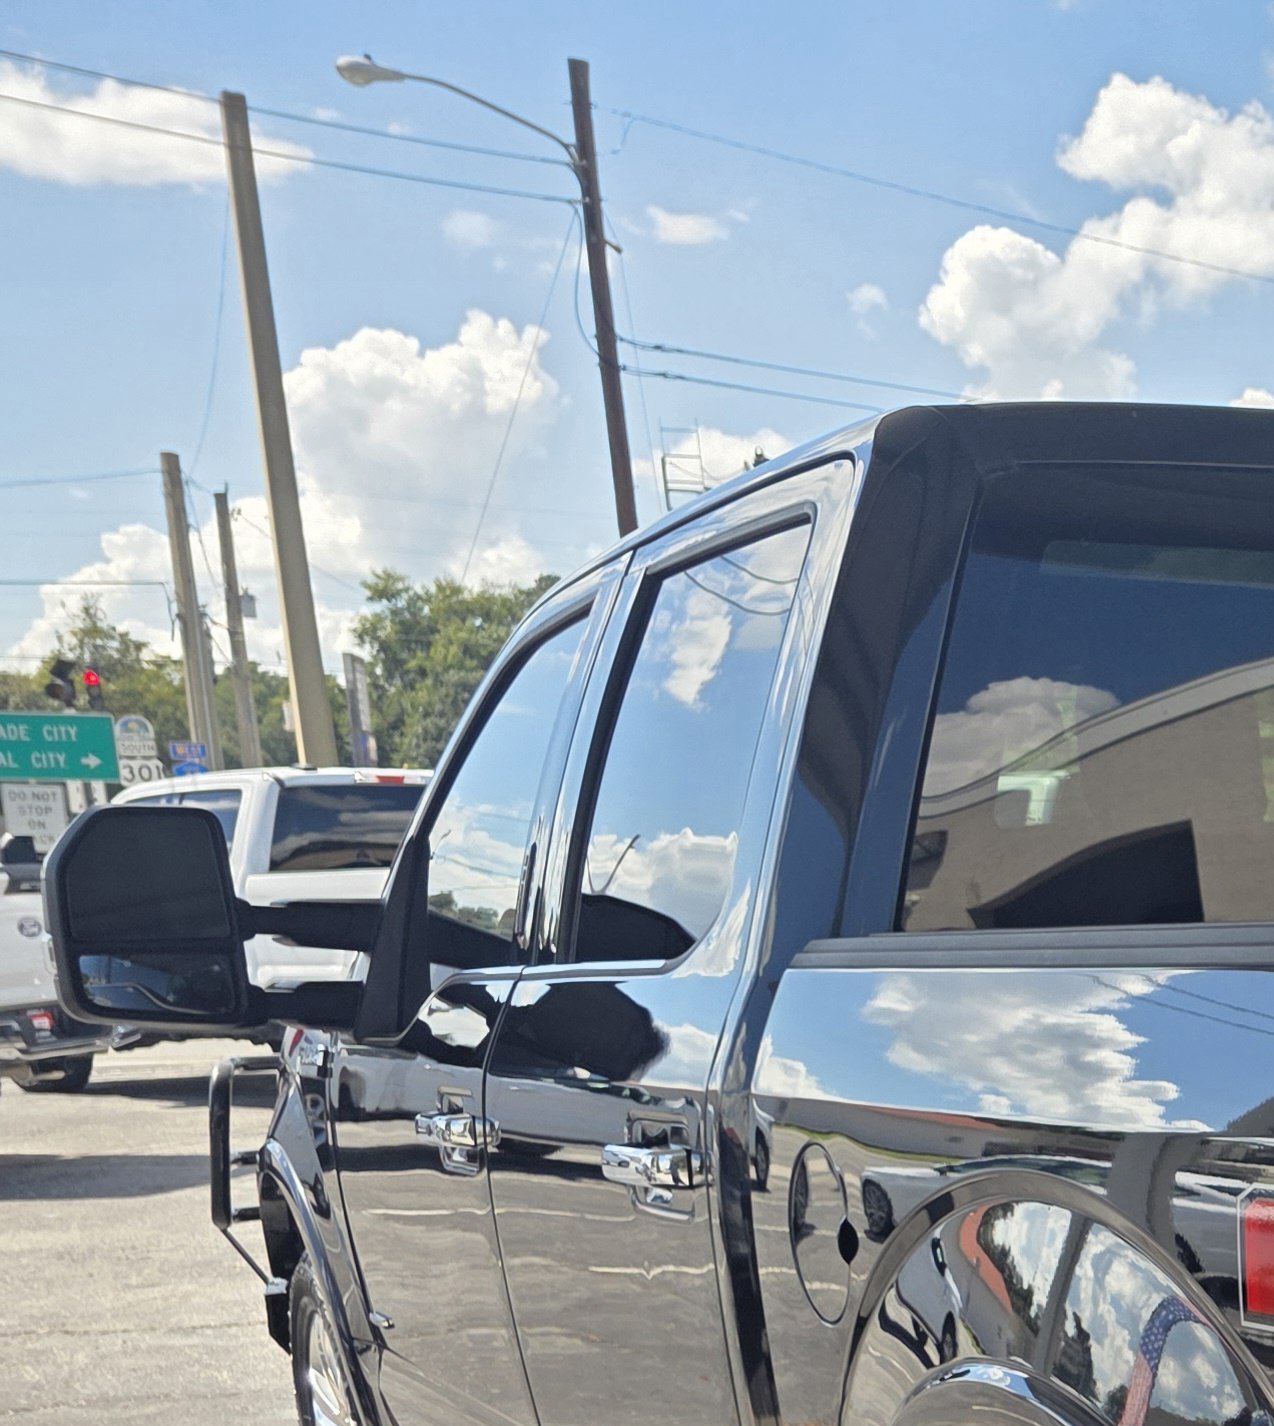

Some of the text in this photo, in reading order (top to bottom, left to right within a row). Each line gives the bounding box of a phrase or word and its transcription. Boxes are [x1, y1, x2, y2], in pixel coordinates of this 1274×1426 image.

[42, 724, 78, 741] CITY
[31, 752, 66, 768] CITY
[122, 764, 162, 782] 301
[8, 790, 58, 802] DO NOT
[17, 803, 53, 816] STOP
[27, 819, 47, 830] ON
